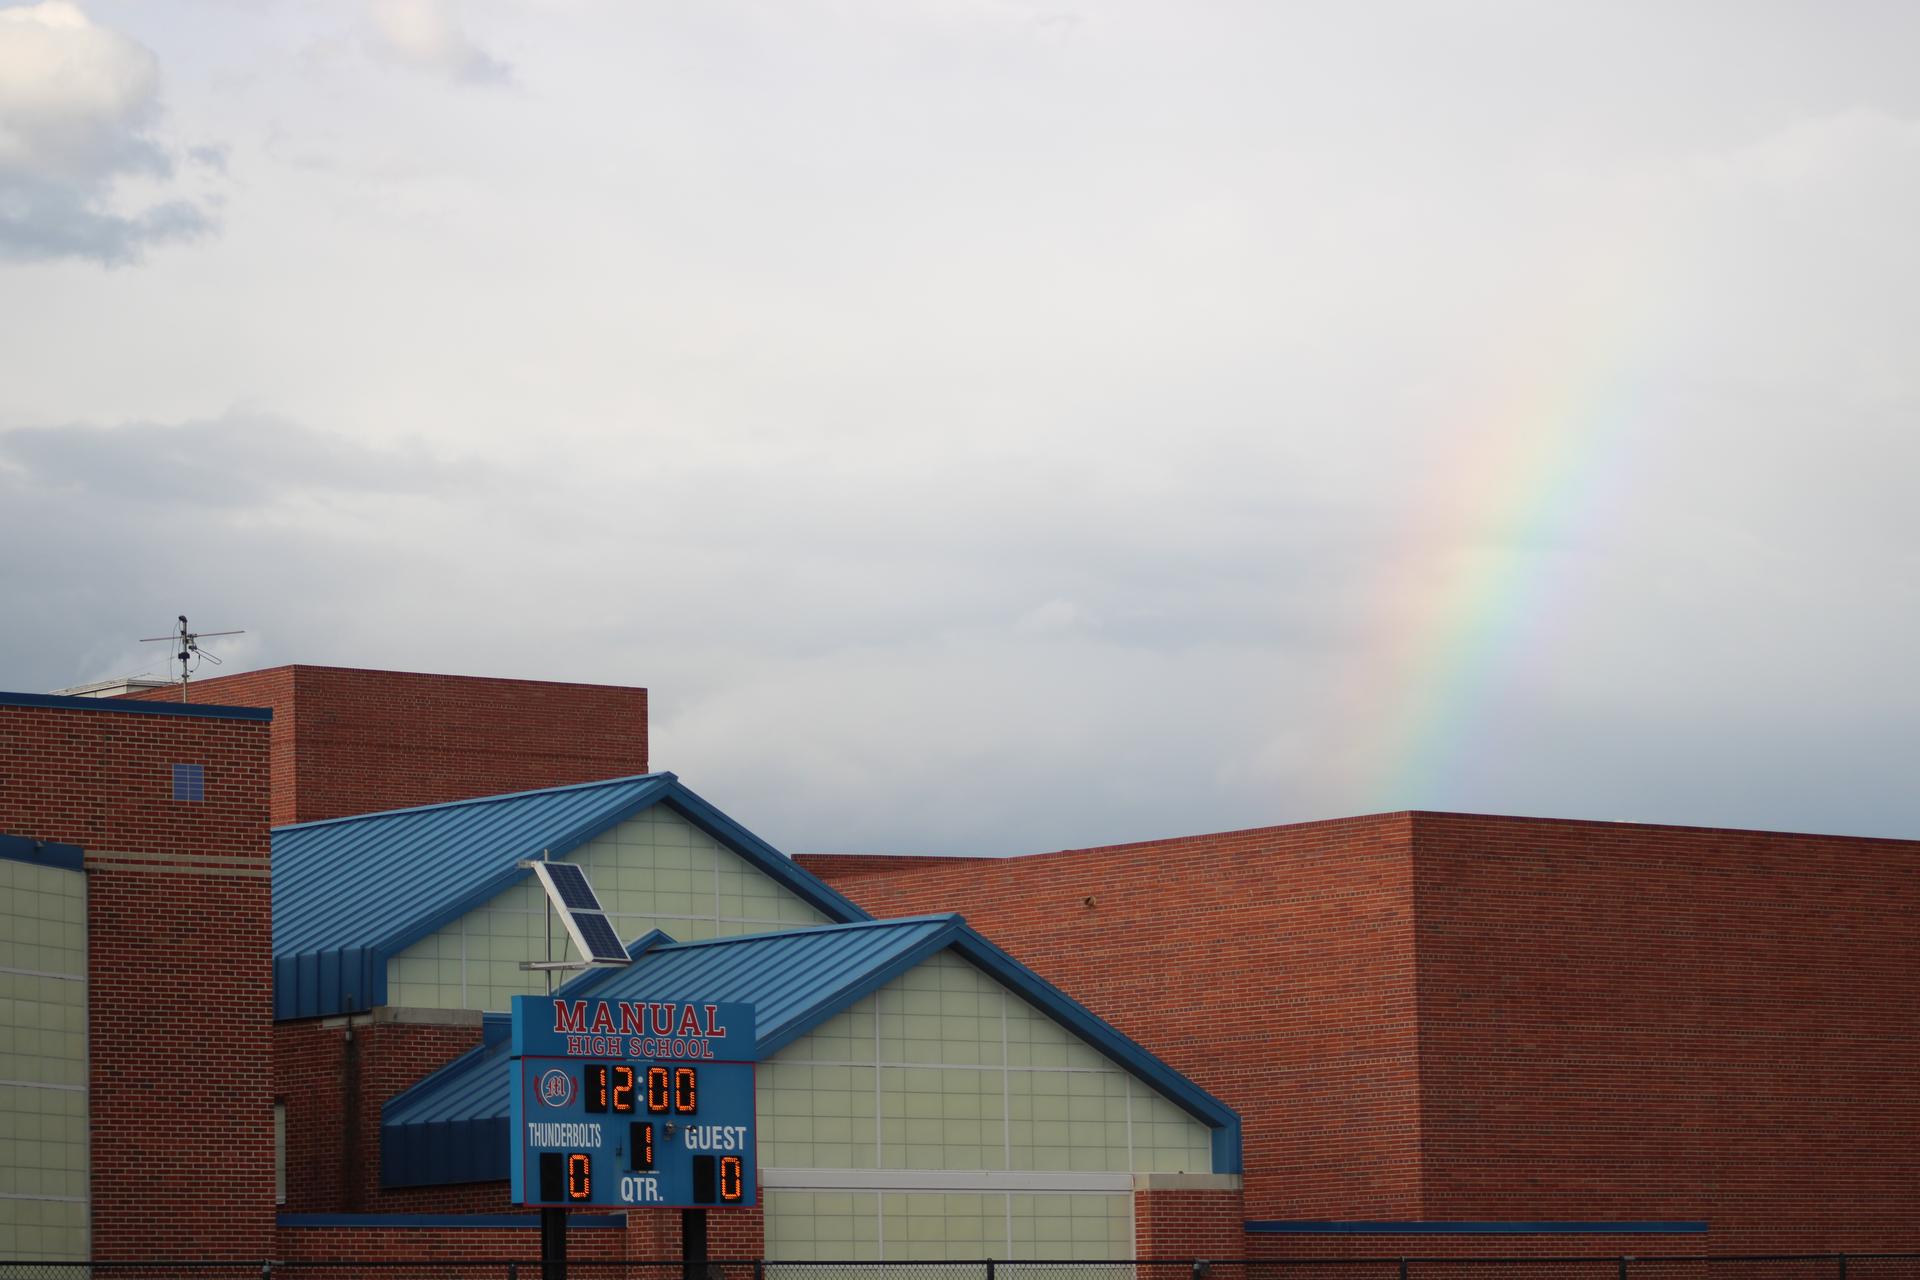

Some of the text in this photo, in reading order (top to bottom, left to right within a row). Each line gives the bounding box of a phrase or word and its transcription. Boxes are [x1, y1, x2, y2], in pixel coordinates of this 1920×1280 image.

[553, 999, 726, 1038] MANUAL
[567, 1035, 714, 1059] HIGH SCHOOL
[600, 1066, 695, 1111] 12:00
[528, 1122, 601, 1148] THUNDERBOLTS
[646, 1125, 653, 1163] 1
[684, 1126, 747, 1150] GUEST
[569, 1154, 589, 1198] 0
[620, 1176, 664, 1202] QTR.
[721, 1157, 741, 1200] 0
